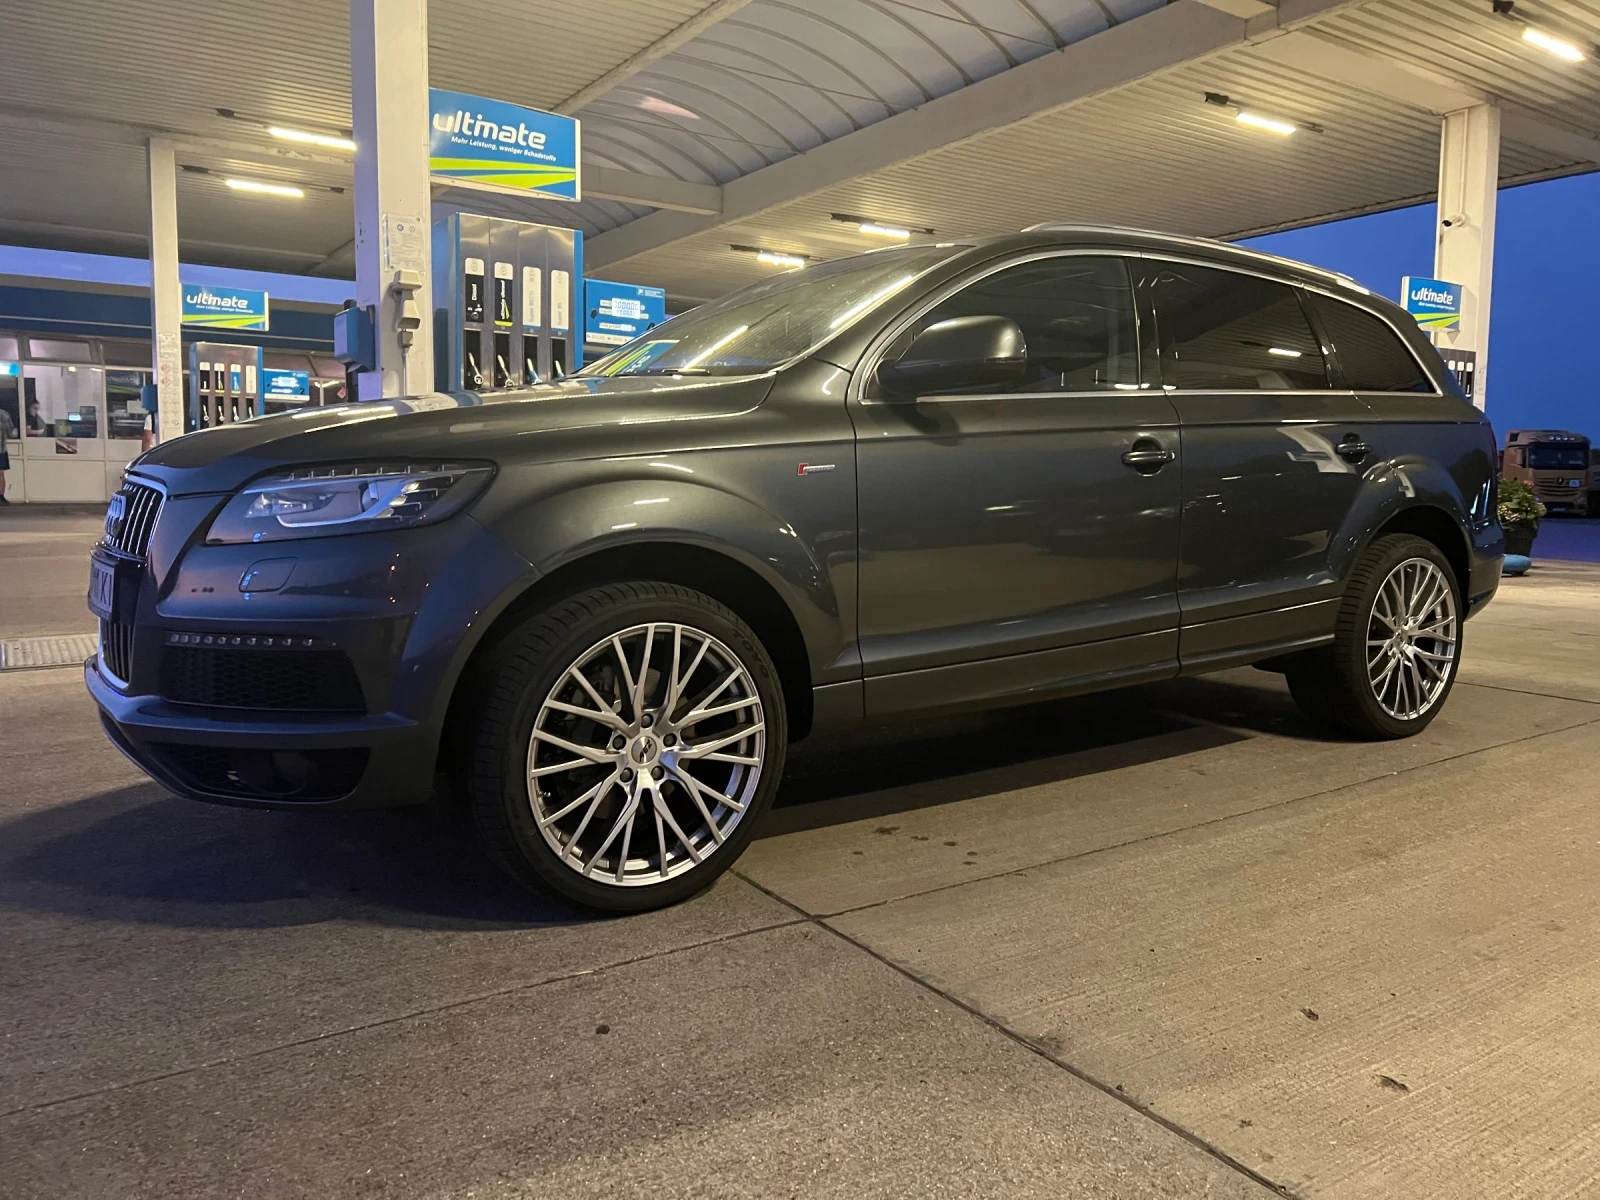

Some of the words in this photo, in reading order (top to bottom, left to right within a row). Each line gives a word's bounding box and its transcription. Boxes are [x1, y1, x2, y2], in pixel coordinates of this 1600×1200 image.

[432, 110, 546, 150] ultimate
[451, 135, 468, 145] Mehr
[469, 138, 498, 151] Leistung,
[499, 145, 524, 155] weniger
[524, 149, 557, 162] Schadstoffe
[186, 292, 248, 309] ultimate
[1411, 287, 1453, 305] ultimate
[730, 628, 771, 680] TOYO
